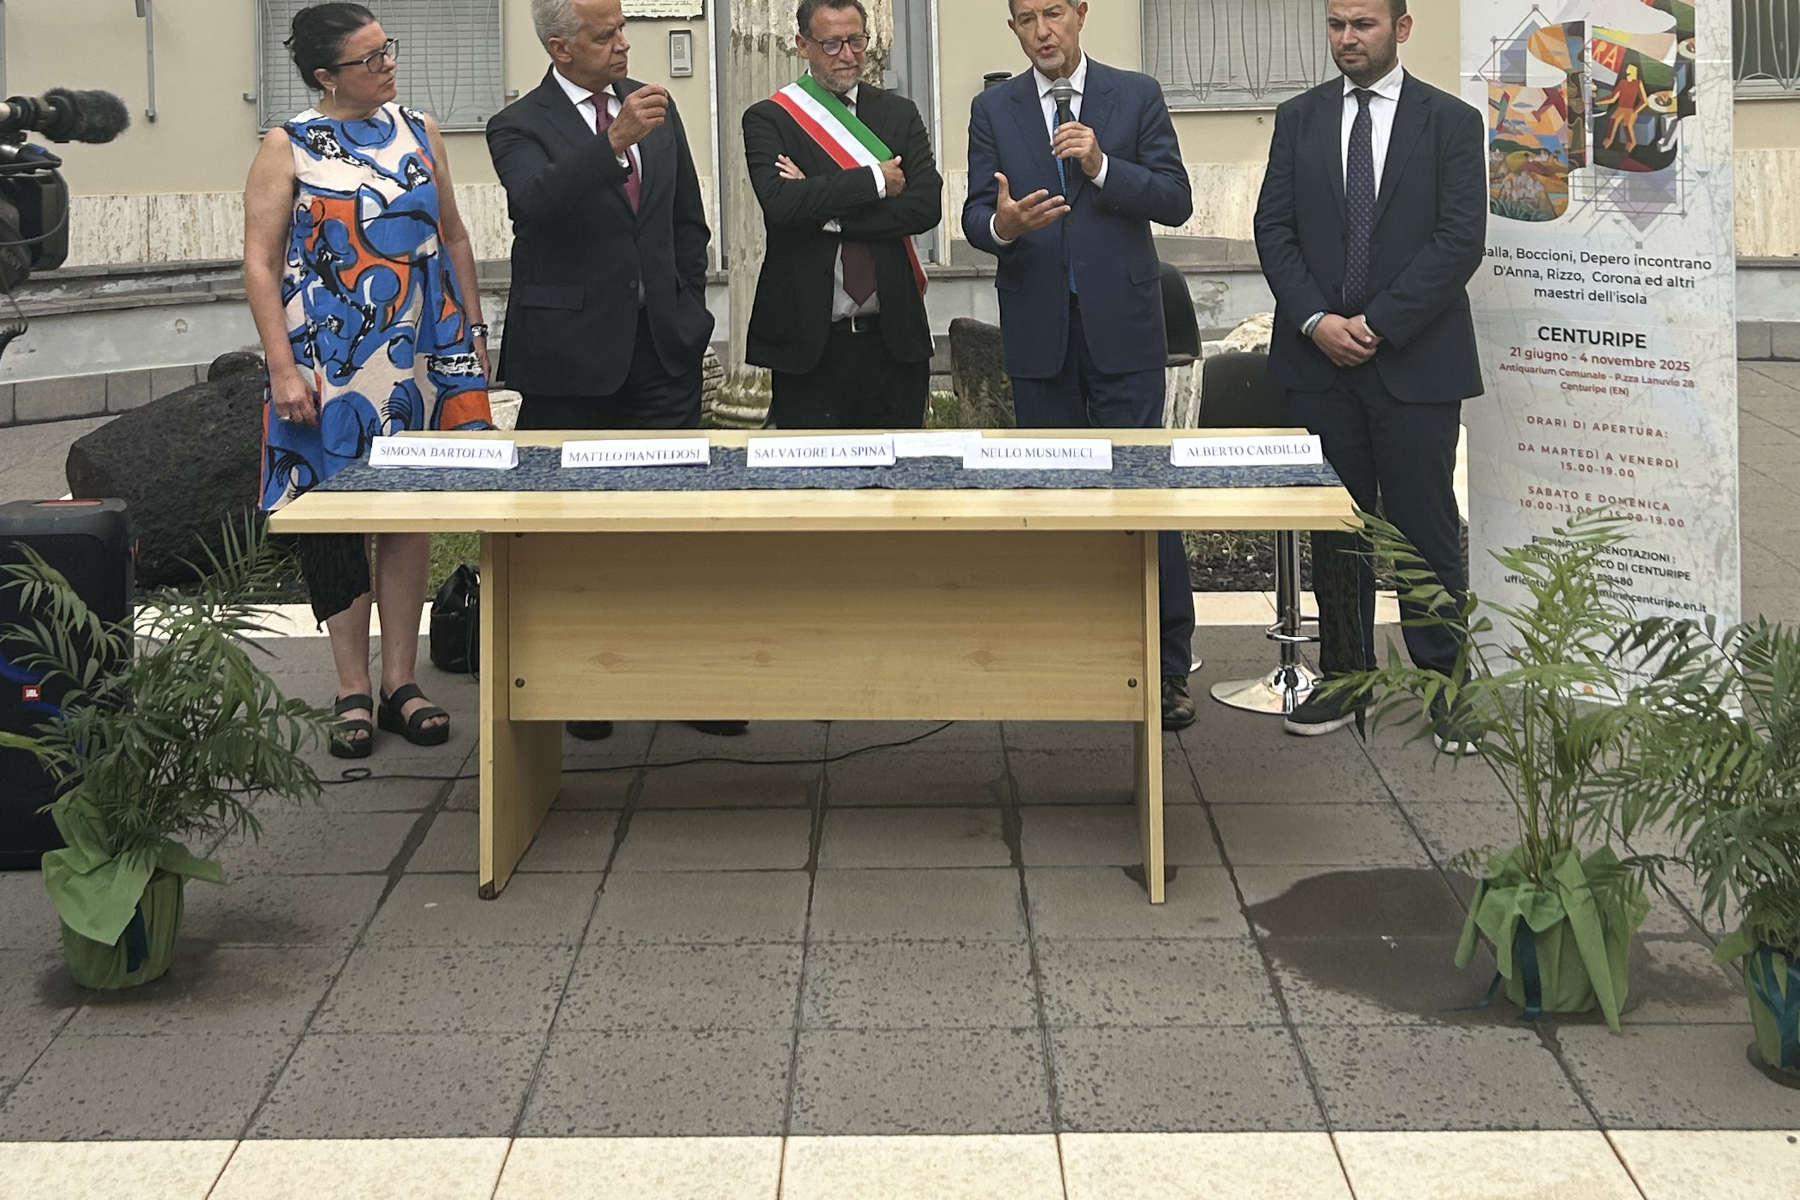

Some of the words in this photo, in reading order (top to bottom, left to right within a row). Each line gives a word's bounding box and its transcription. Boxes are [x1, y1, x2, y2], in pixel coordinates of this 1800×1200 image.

[1516, 247, 1576, 265] Boccioni,
[1580, 251, 1630, 267] Depero
[1634, 253, 1712, 271] incontrano
[1493, 265, 1543, 281] D'Anna,
[1547, 268, 1585, 284] Rizzo,
[1592, 271, 1641, 286] Corona
[1645, 275, 1663, 287] ed
[1666, 275, 1695, 289] altri
[1534, 286, 1584, 301] maestri
[1588, 288, 1648, 305] dell'isola
[1537, 326, 1648, 349] CENTURIPE
[1509, 346, 1522, 358] 21
[1525, 347, 1568, 362] giugno
[1579, 352, 1588, 363] 4
[1591, 353, 1656, 368] novembre
[1660, 359, 1691, 372] 2025
[1499, 363, 1557, 376] Antiquarium
[1559, 368, 1607, 381] Comunale
[1641, 375, 1680, 388] Lanuvio
[1560, 381, 1607, 395] Centuripe
[1609, 385, 1629, 397] (EN)
[1526, 415, 1567, 428] ORARI
[1573, 420, 1586, 430] DI
[1592, 422, 1669, 439] APERTURA:
[379, 446, 427, 457] SIMONA
[430, 447, 503, 459] BARTOLENA
[568, 450, 622, 463] MATTEO
[625, 448, 700, 461] PIANTEDOSI
[754, 447, 828, 459] SALVATORE
[831, 446, 847, 458] LA
[850, 445, 886, 457] SPINA
[980, 447, 1022, 459] NELLO
[1024, 447, 1093, 459] MUSUMECI
[1187, 445, 1244, 458] ALBERTO
[1247, 443, 1311, 456] CARDILLO
[1518, 442, 1535, 452] DA
[1605, 452, 1614, 461] A
[1560, 461, 1635, 478] 15.00-19.00
[1528, 485, 1580, 500] SABATO
[1585, 492, 1592, 502] E
[1598, 494, 1671, 512] DOMENICA
[1617, 563, 1629, 573] DI
[1631, 564, 1692, 581] CENTURIPE
